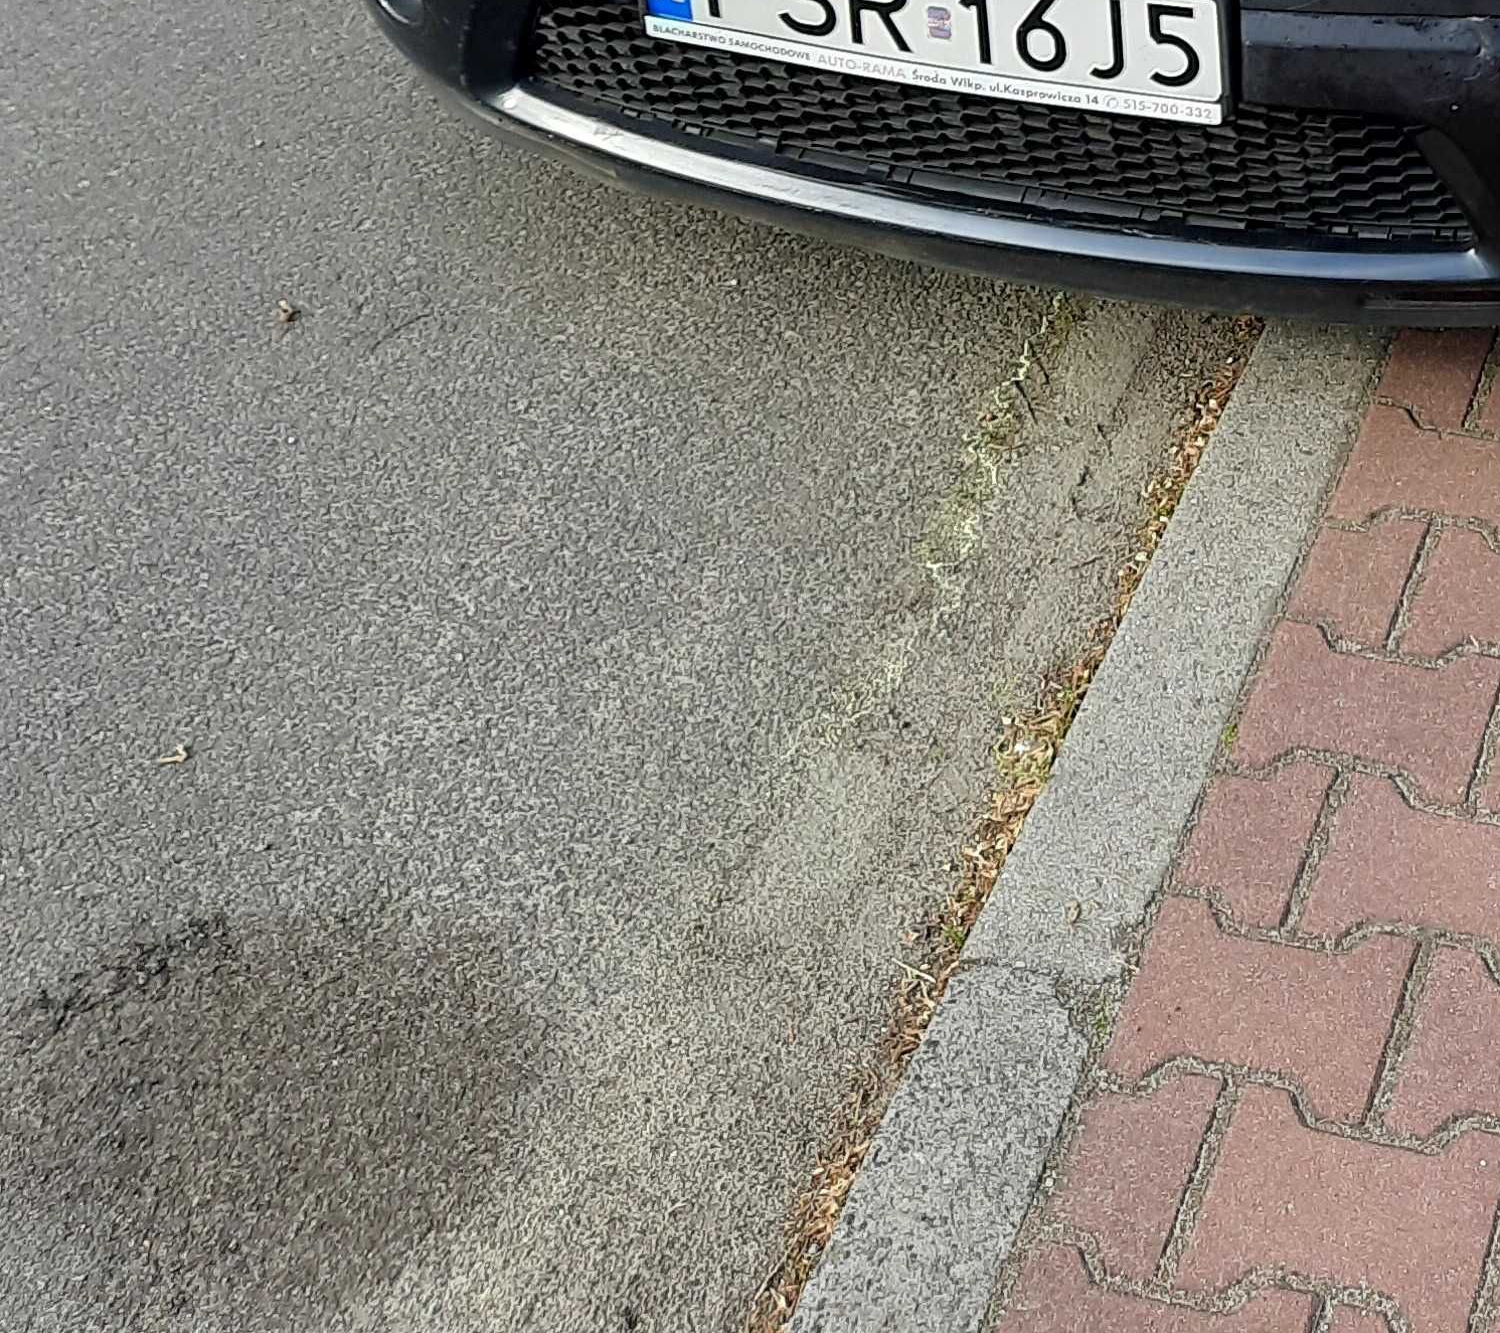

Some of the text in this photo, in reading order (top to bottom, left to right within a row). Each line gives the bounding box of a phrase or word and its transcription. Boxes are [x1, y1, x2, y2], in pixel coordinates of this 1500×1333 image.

[652, 24, 726, 44] BLACHARSTWO
[728, 38, 811, 61] SAMOCHODOWE
[818, 54, 907, 79] AUTO-RAMA
[912, 69, 947, 85] Środa
[951, 76, 986, 91] Wlkp.
[1085, 94, 1099, 105] 14
[1123, 98, 1213, 120] 515-700-332
